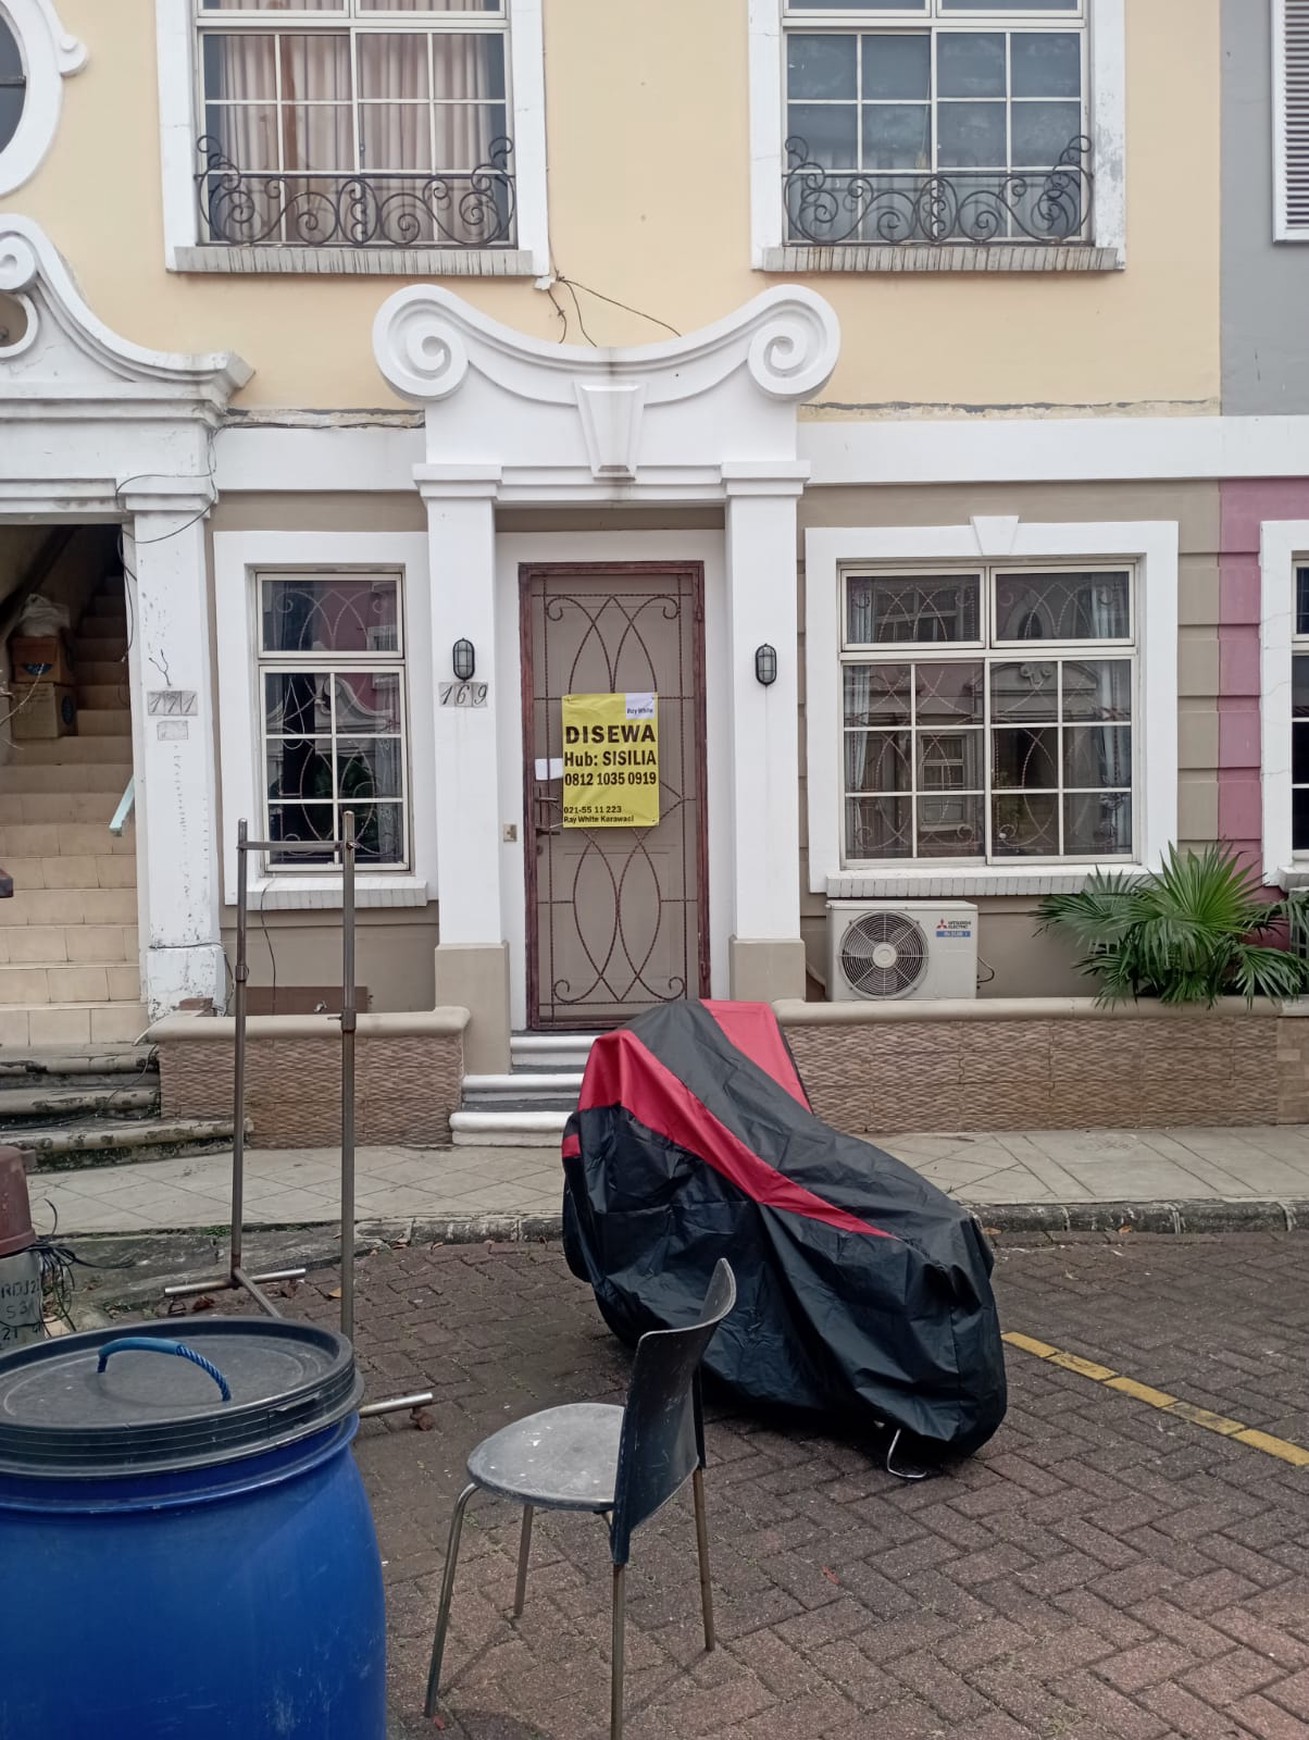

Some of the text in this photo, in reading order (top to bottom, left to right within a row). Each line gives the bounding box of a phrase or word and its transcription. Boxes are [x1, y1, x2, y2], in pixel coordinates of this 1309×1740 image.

[441, 684, 487, 705] 169
[565, 724, 656, 744] DISEWA
[564, 750, 657, 767] Hub: SISILIA
[565, 771, 657, 786] 0812 1035 0919
[563, 806, 592, 814] 021-55
[606, 805, 622, 813] 223
[563, 816, 577, 824] Ray
[578, 815, 599, 823] White
